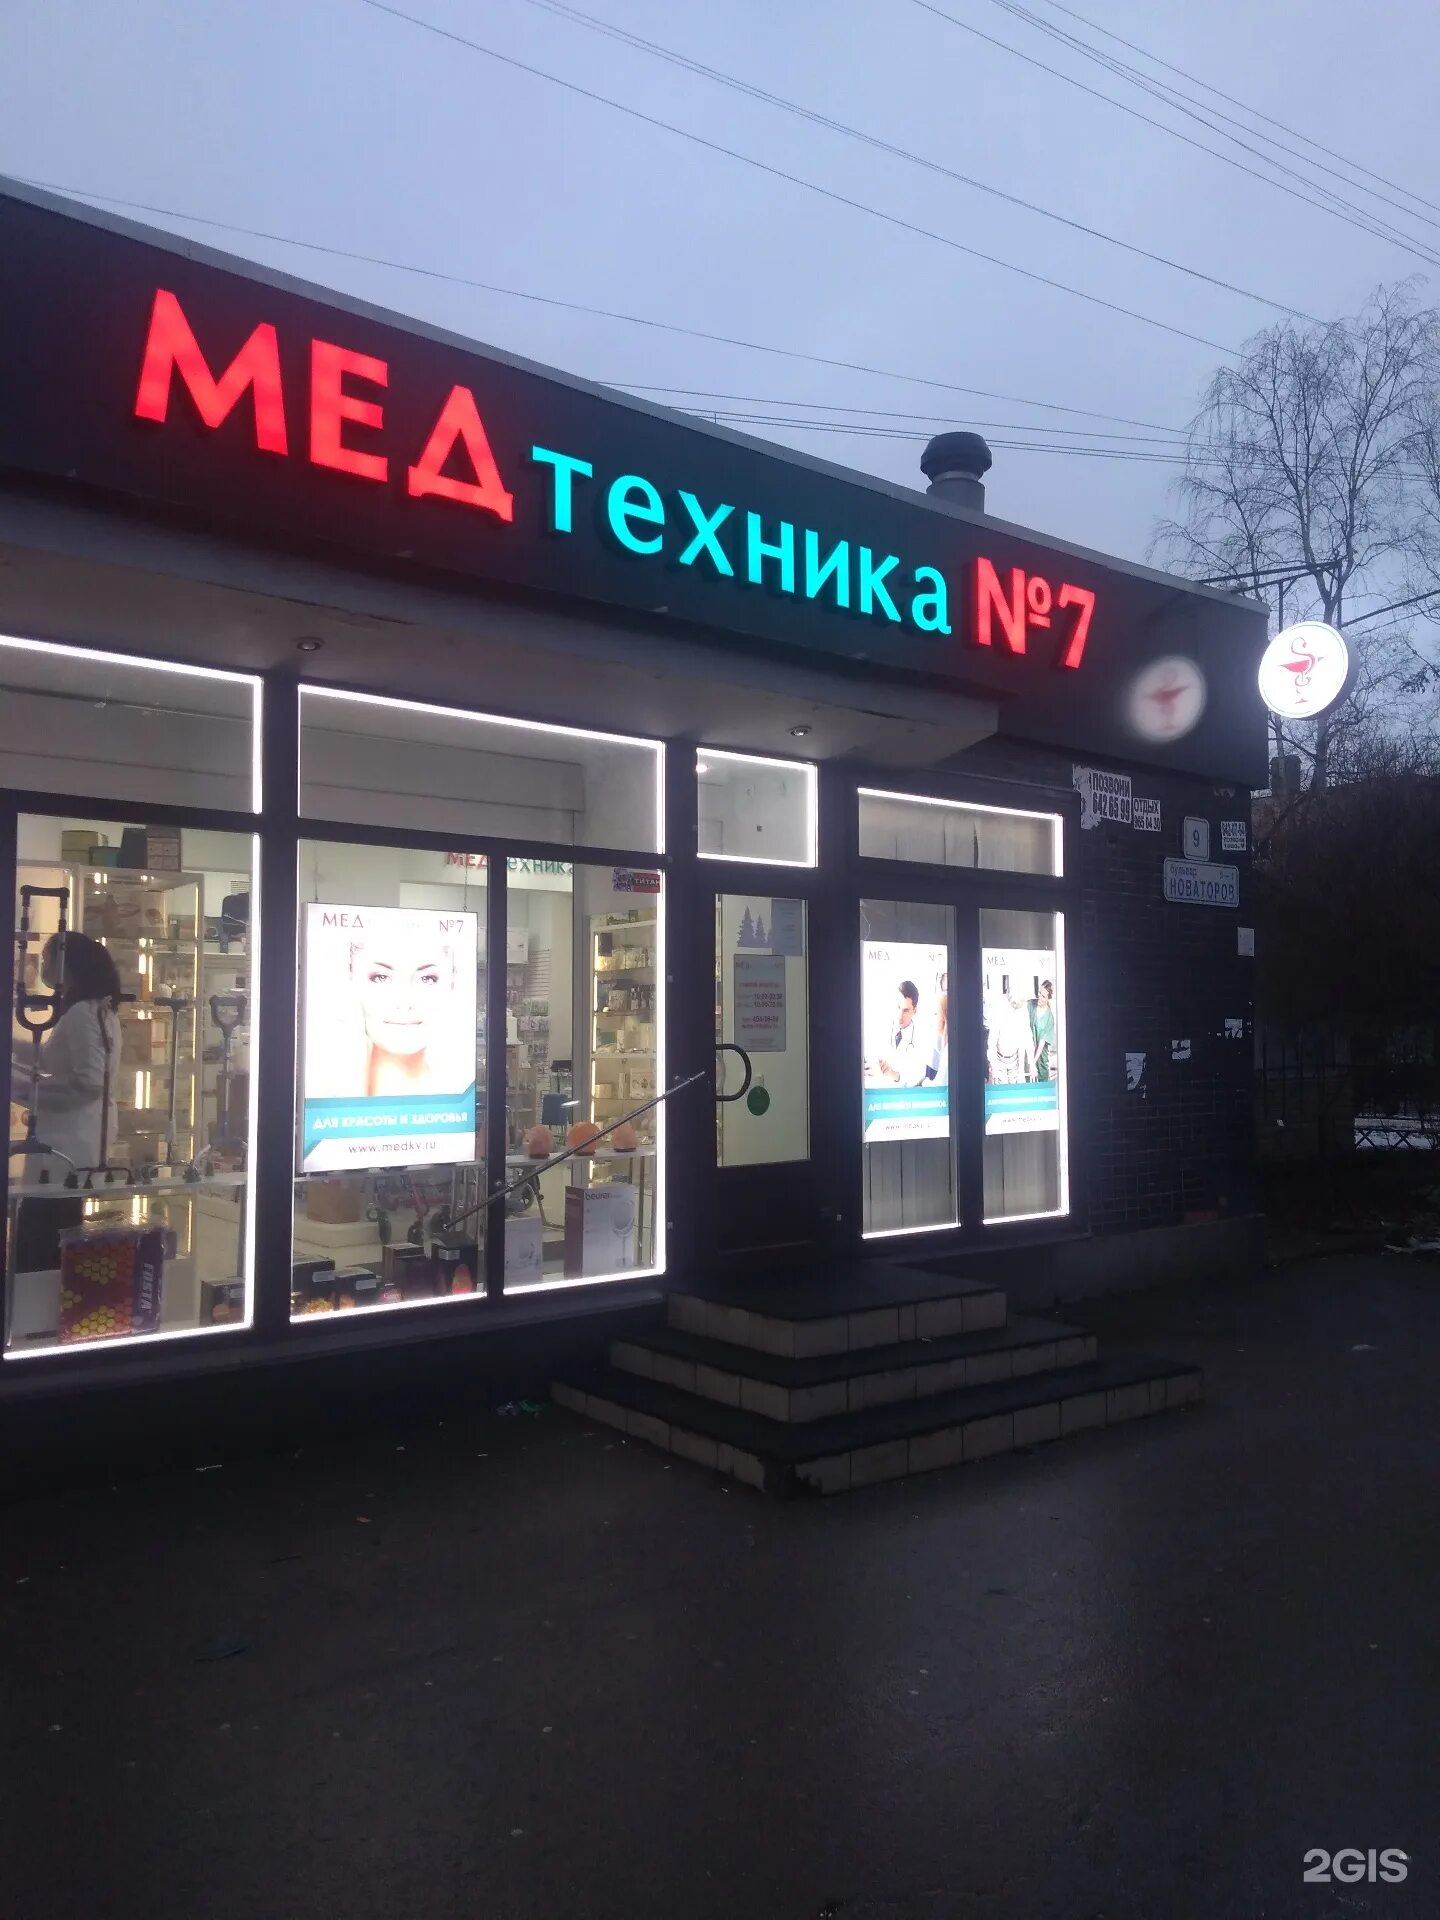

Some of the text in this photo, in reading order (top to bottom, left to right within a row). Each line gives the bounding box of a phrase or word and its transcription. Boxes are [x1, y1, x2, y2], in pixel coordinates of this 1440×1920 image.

[976, 557, 1096, 669] №7
[1092, 773, 1130, 798] ПОЗВОНИ
[1109, 796, 1119, 819] 65
[1120, 799, 1130, 821] 99
[1133, 799, 1159, 815] ОТДЫХ
[1192, 829, 1200, 848] 9
[1170, 878, 1235, 900] НОВАТОРОВ
[313, 1111, 468, 1129] ДЛЯ КРАСОТЫ И ЗДОРОВЬЯ
